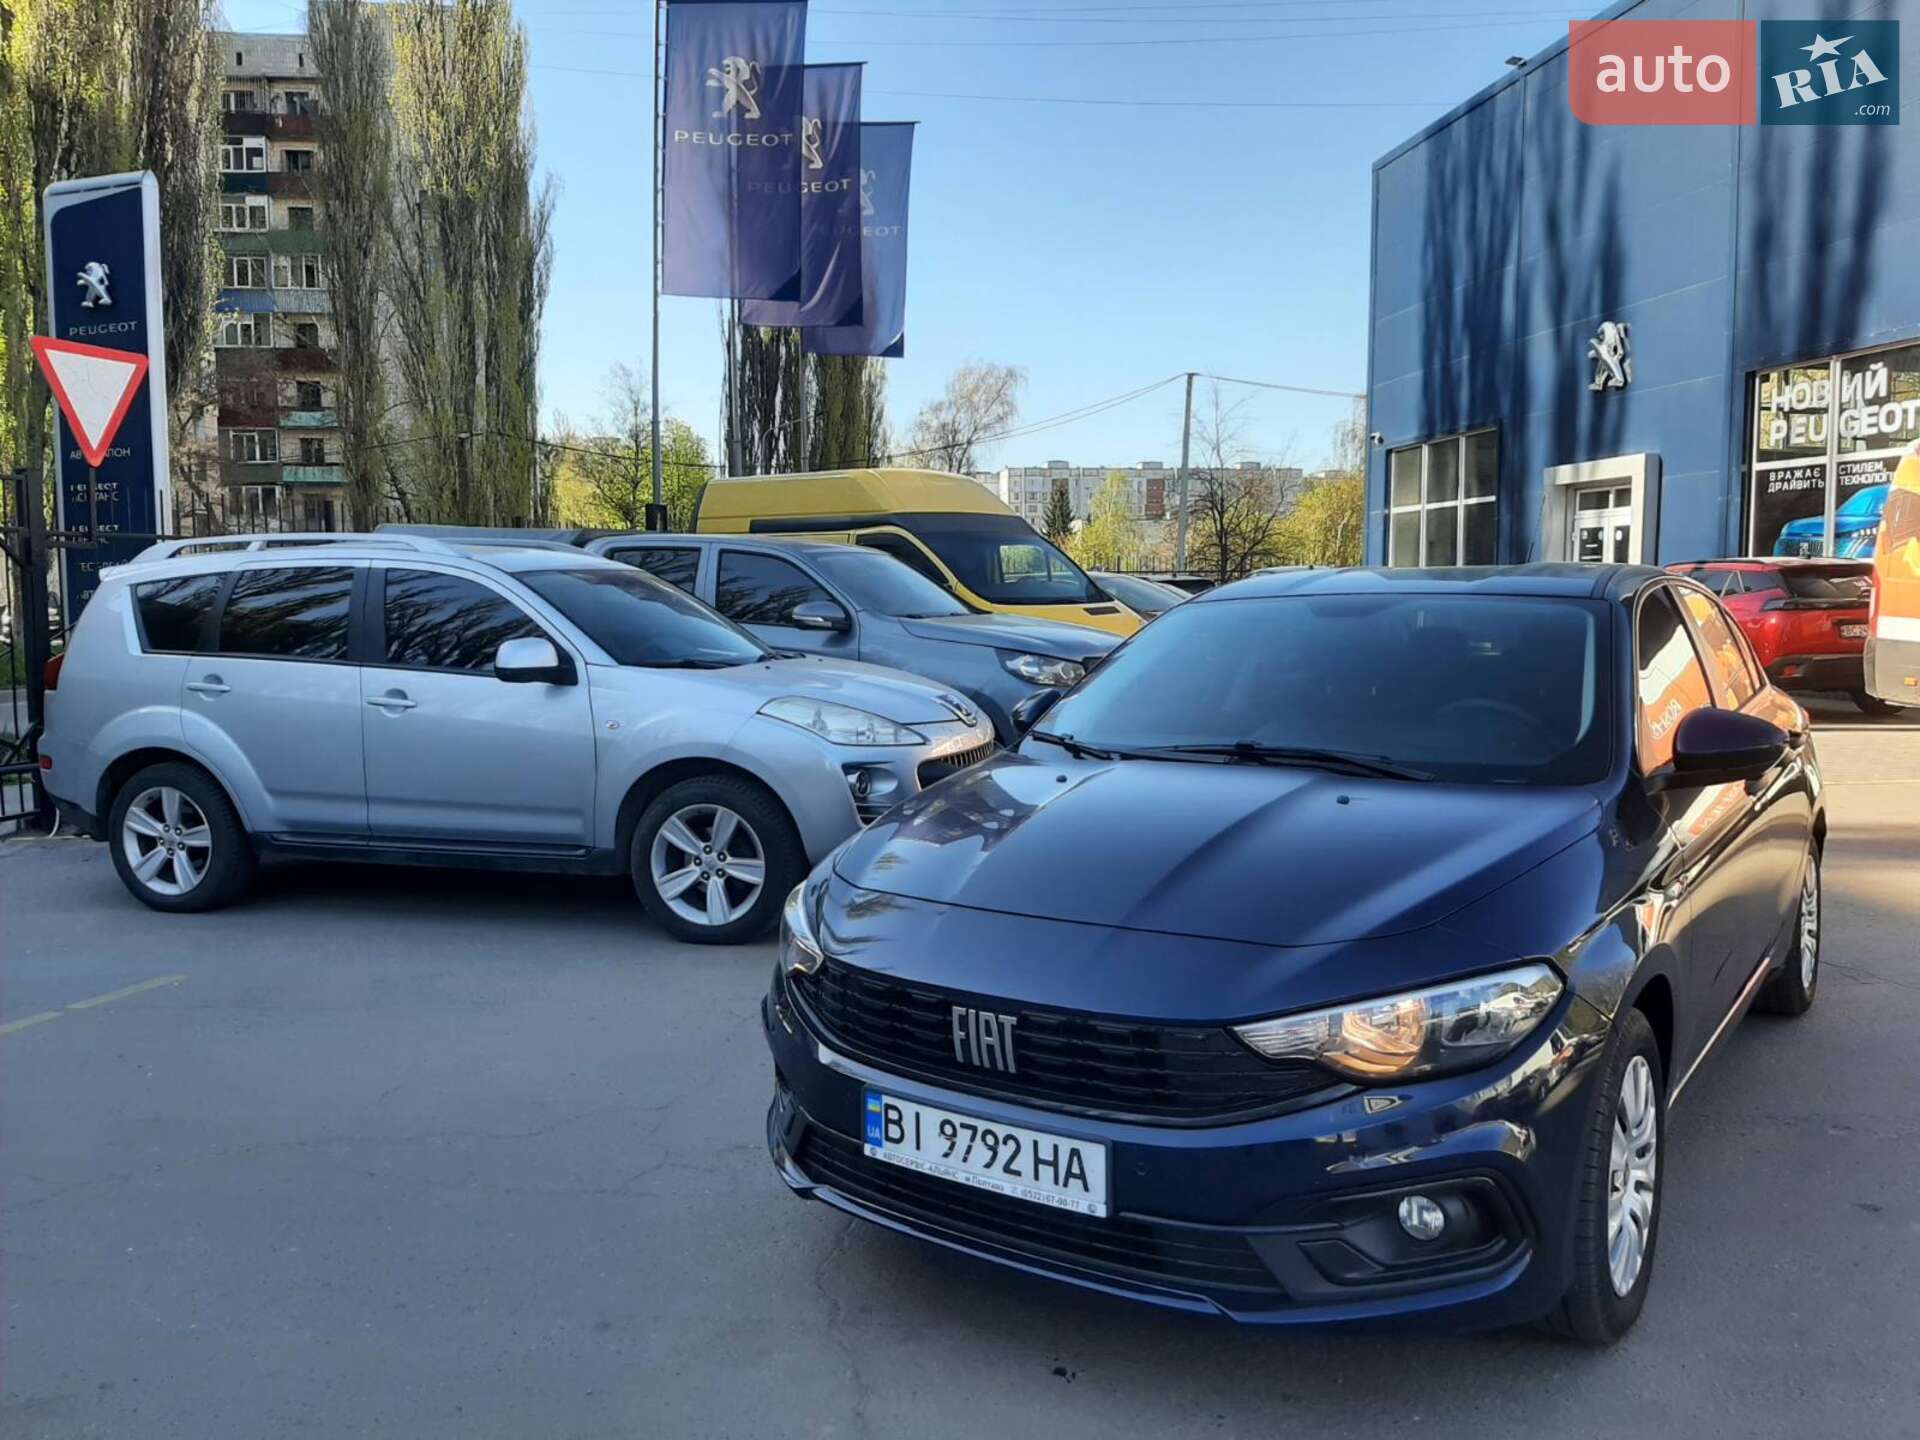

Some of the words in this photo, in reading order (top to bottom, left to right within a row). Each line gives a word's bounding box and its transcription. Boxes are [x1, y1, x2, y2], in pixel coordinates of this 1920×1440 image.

[674, 130, 794, 147] PEUGEOT
[68, 320, 138, 337] PEUGEOT
[1771, 361, 1889, 413] НОВИЙ
[1769, 399, 1920, 447] PEUGEOT
[1769, 467, 1821, 482] ВРАЖАЄ
[1767, 478, 1825, 493] ДРАЙВИТЬ
[952, 1006, 1018, 1074] FIAT
[867, 1123, 881, 1139] UA
[884, 1102, 921, 1151] BI
[939, 1118, 1022, 1177] 9792
[1033, 1138, 1090, 1193] HA
